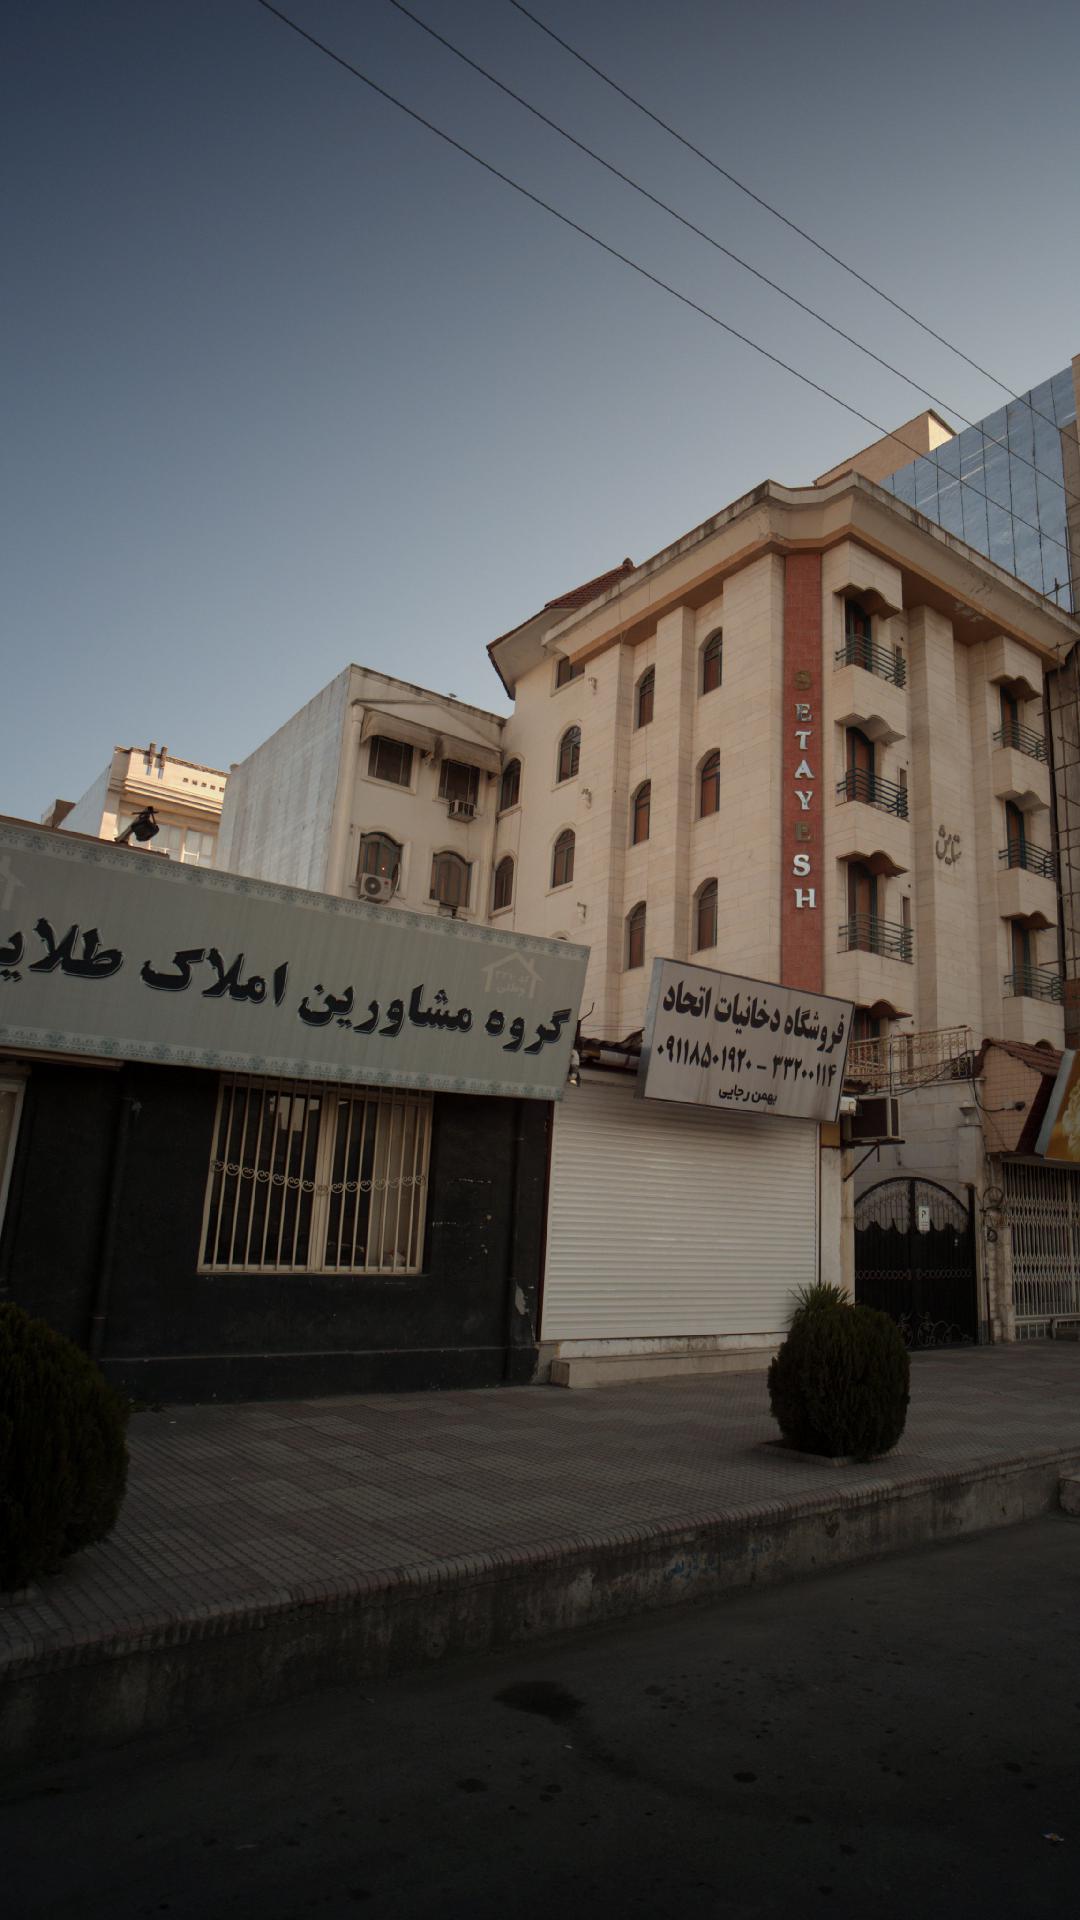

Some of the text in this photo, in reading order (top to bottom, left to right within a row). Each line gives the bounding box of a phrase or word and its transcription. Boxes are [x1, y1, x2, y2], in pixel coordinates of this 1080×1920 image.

[793, 670, 816, 909] SETAYESH
[140, 947, 289, 1006] املاک
[298, 984, 473, 1037] مشاورین
[485, 1009, 573, 1055] گروه
[663, 981, 845, 1054] فروشگاه دخانیات اتحاد
[657, 1035, 752, 1073] ۰۹۱۱۸۵۰۱۹۲۰
[718, 1084, 778, 1105] بهمن رجایی
